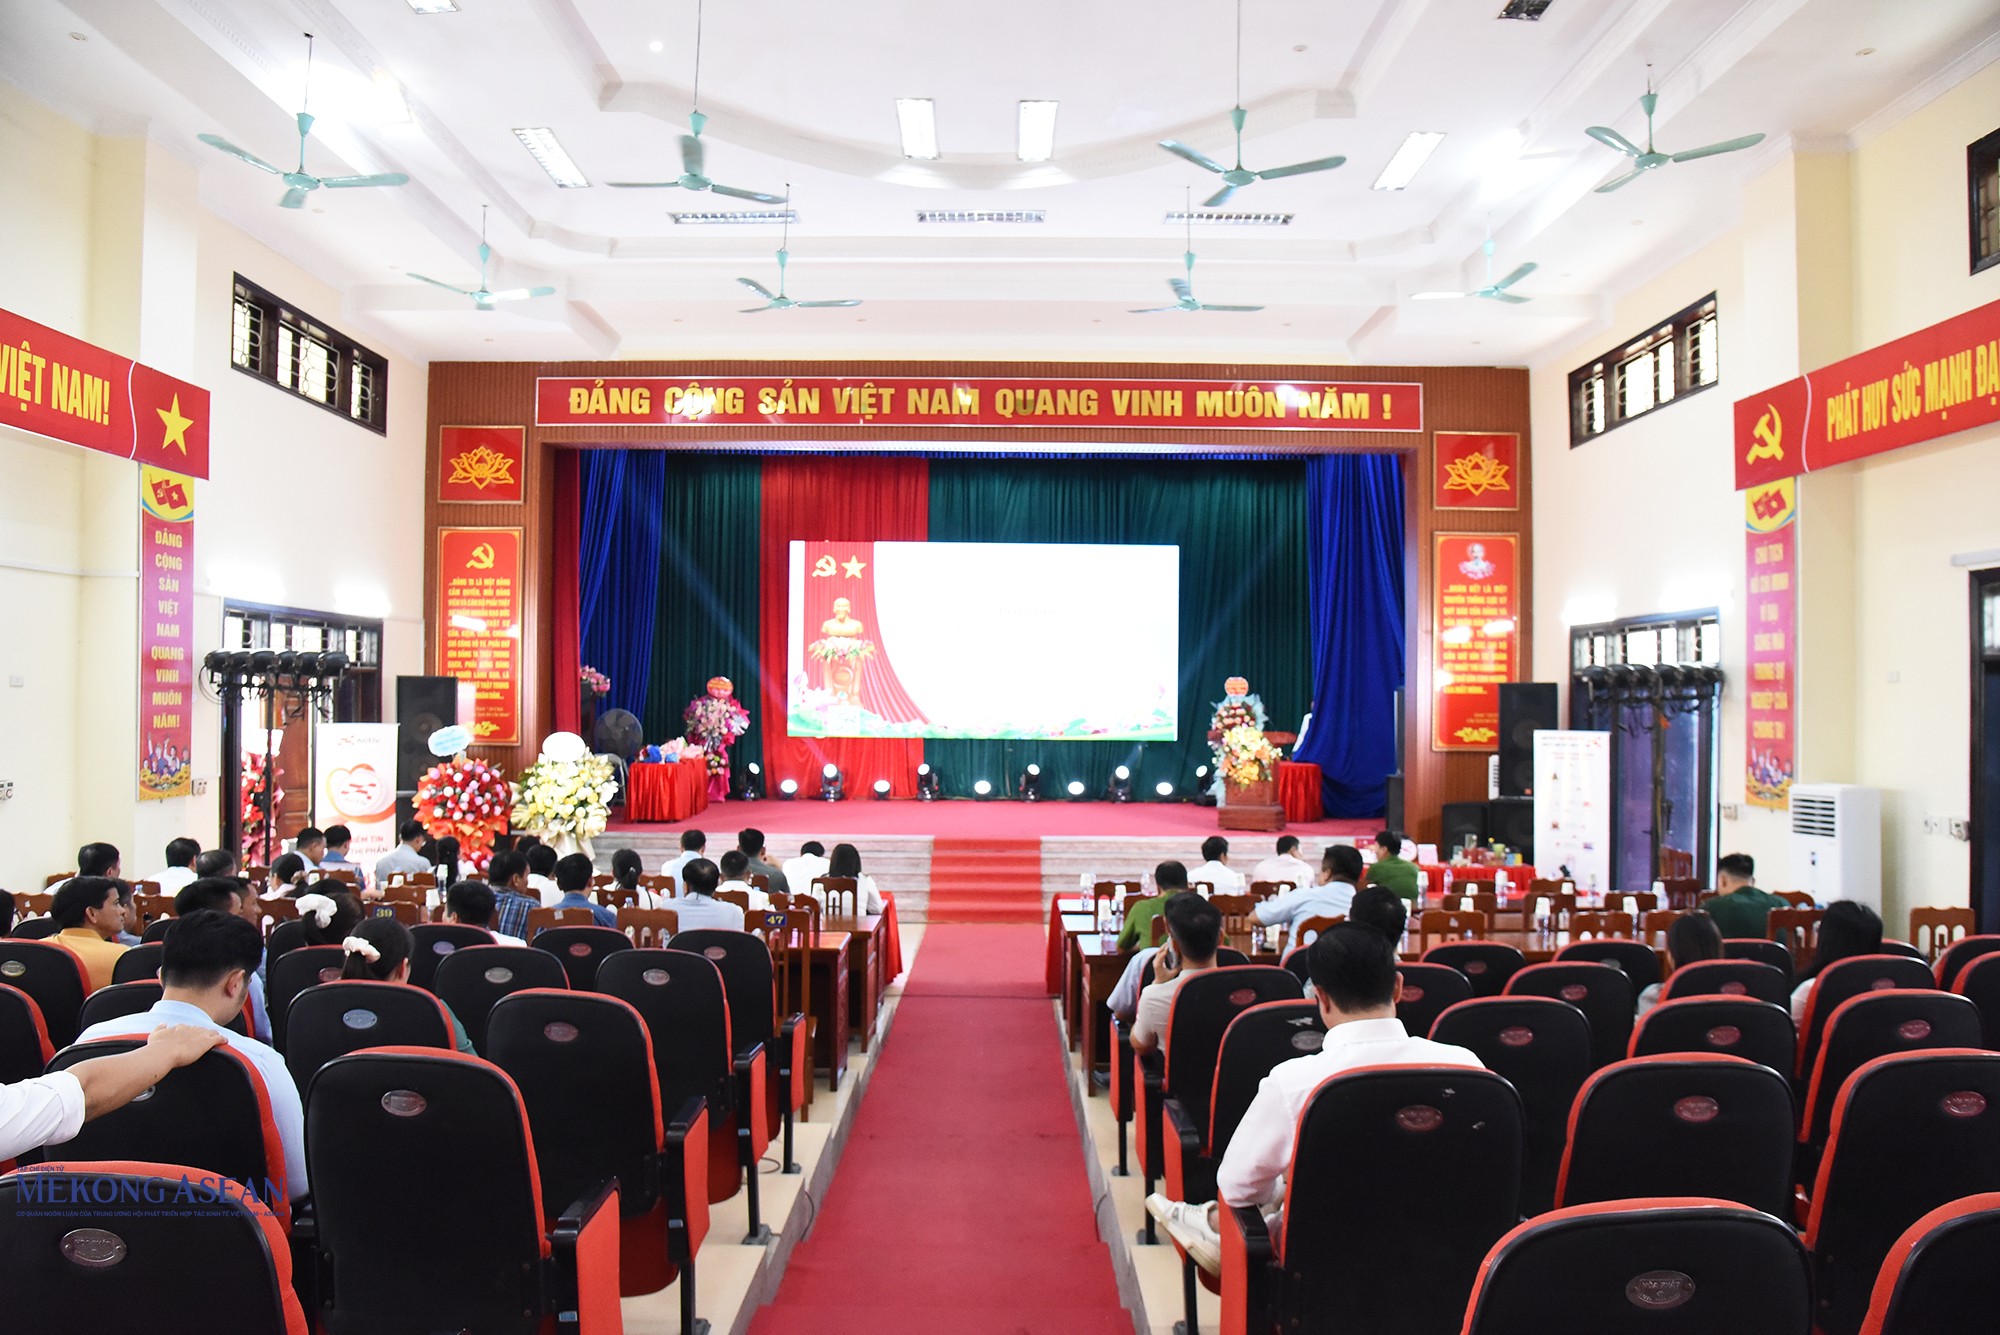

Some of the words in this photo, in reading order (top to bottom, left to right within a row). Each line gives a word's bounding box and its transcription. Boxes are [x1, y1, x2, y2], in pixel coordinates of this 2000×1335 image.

[0, 340, 46, 412] VIỆT
[51, 361, 110, 426] NAM!
[1826, 381, 1860, 442] PHÁT
[1862, 378, 1889, 432] HUY
[1892, 360, 1921, 423] SỨC
[1924, 349, 1973, 420] MẠNH
[1976, 339, 2000, 406] ĐẠ
[568, 378, 651, 415] ĐẢNG
[664, 382, 745, 421] CỘNG
[757, 378, 820, 415] SẢN
[832, 382, 896, 420] VIỆT
[907, 387, 980, 415] NAM
[994, 388, 1099, 418] QUANG
[1111, 389, 1183, 417] VINH
[1196, 385, 1287, 418] MUÔN
[1297, 386, 1370, 420] NĂM
[155, 527, 183, 548] ĐẢNG
[155, 552, 183, 571] CỘNG
[158, 573, 179, 593] SẢN
[158, 598, 179, 618] VIỆT
[156, 622, 180, 638] NAM
[151, 645, 184, 661] QUANG
[155, 668, 180, 683] VINH
[152, 689, 182, 706] MUÔN
[153, 712, 180, 729] NĂM!
[767, 915, 784, 925] 47
